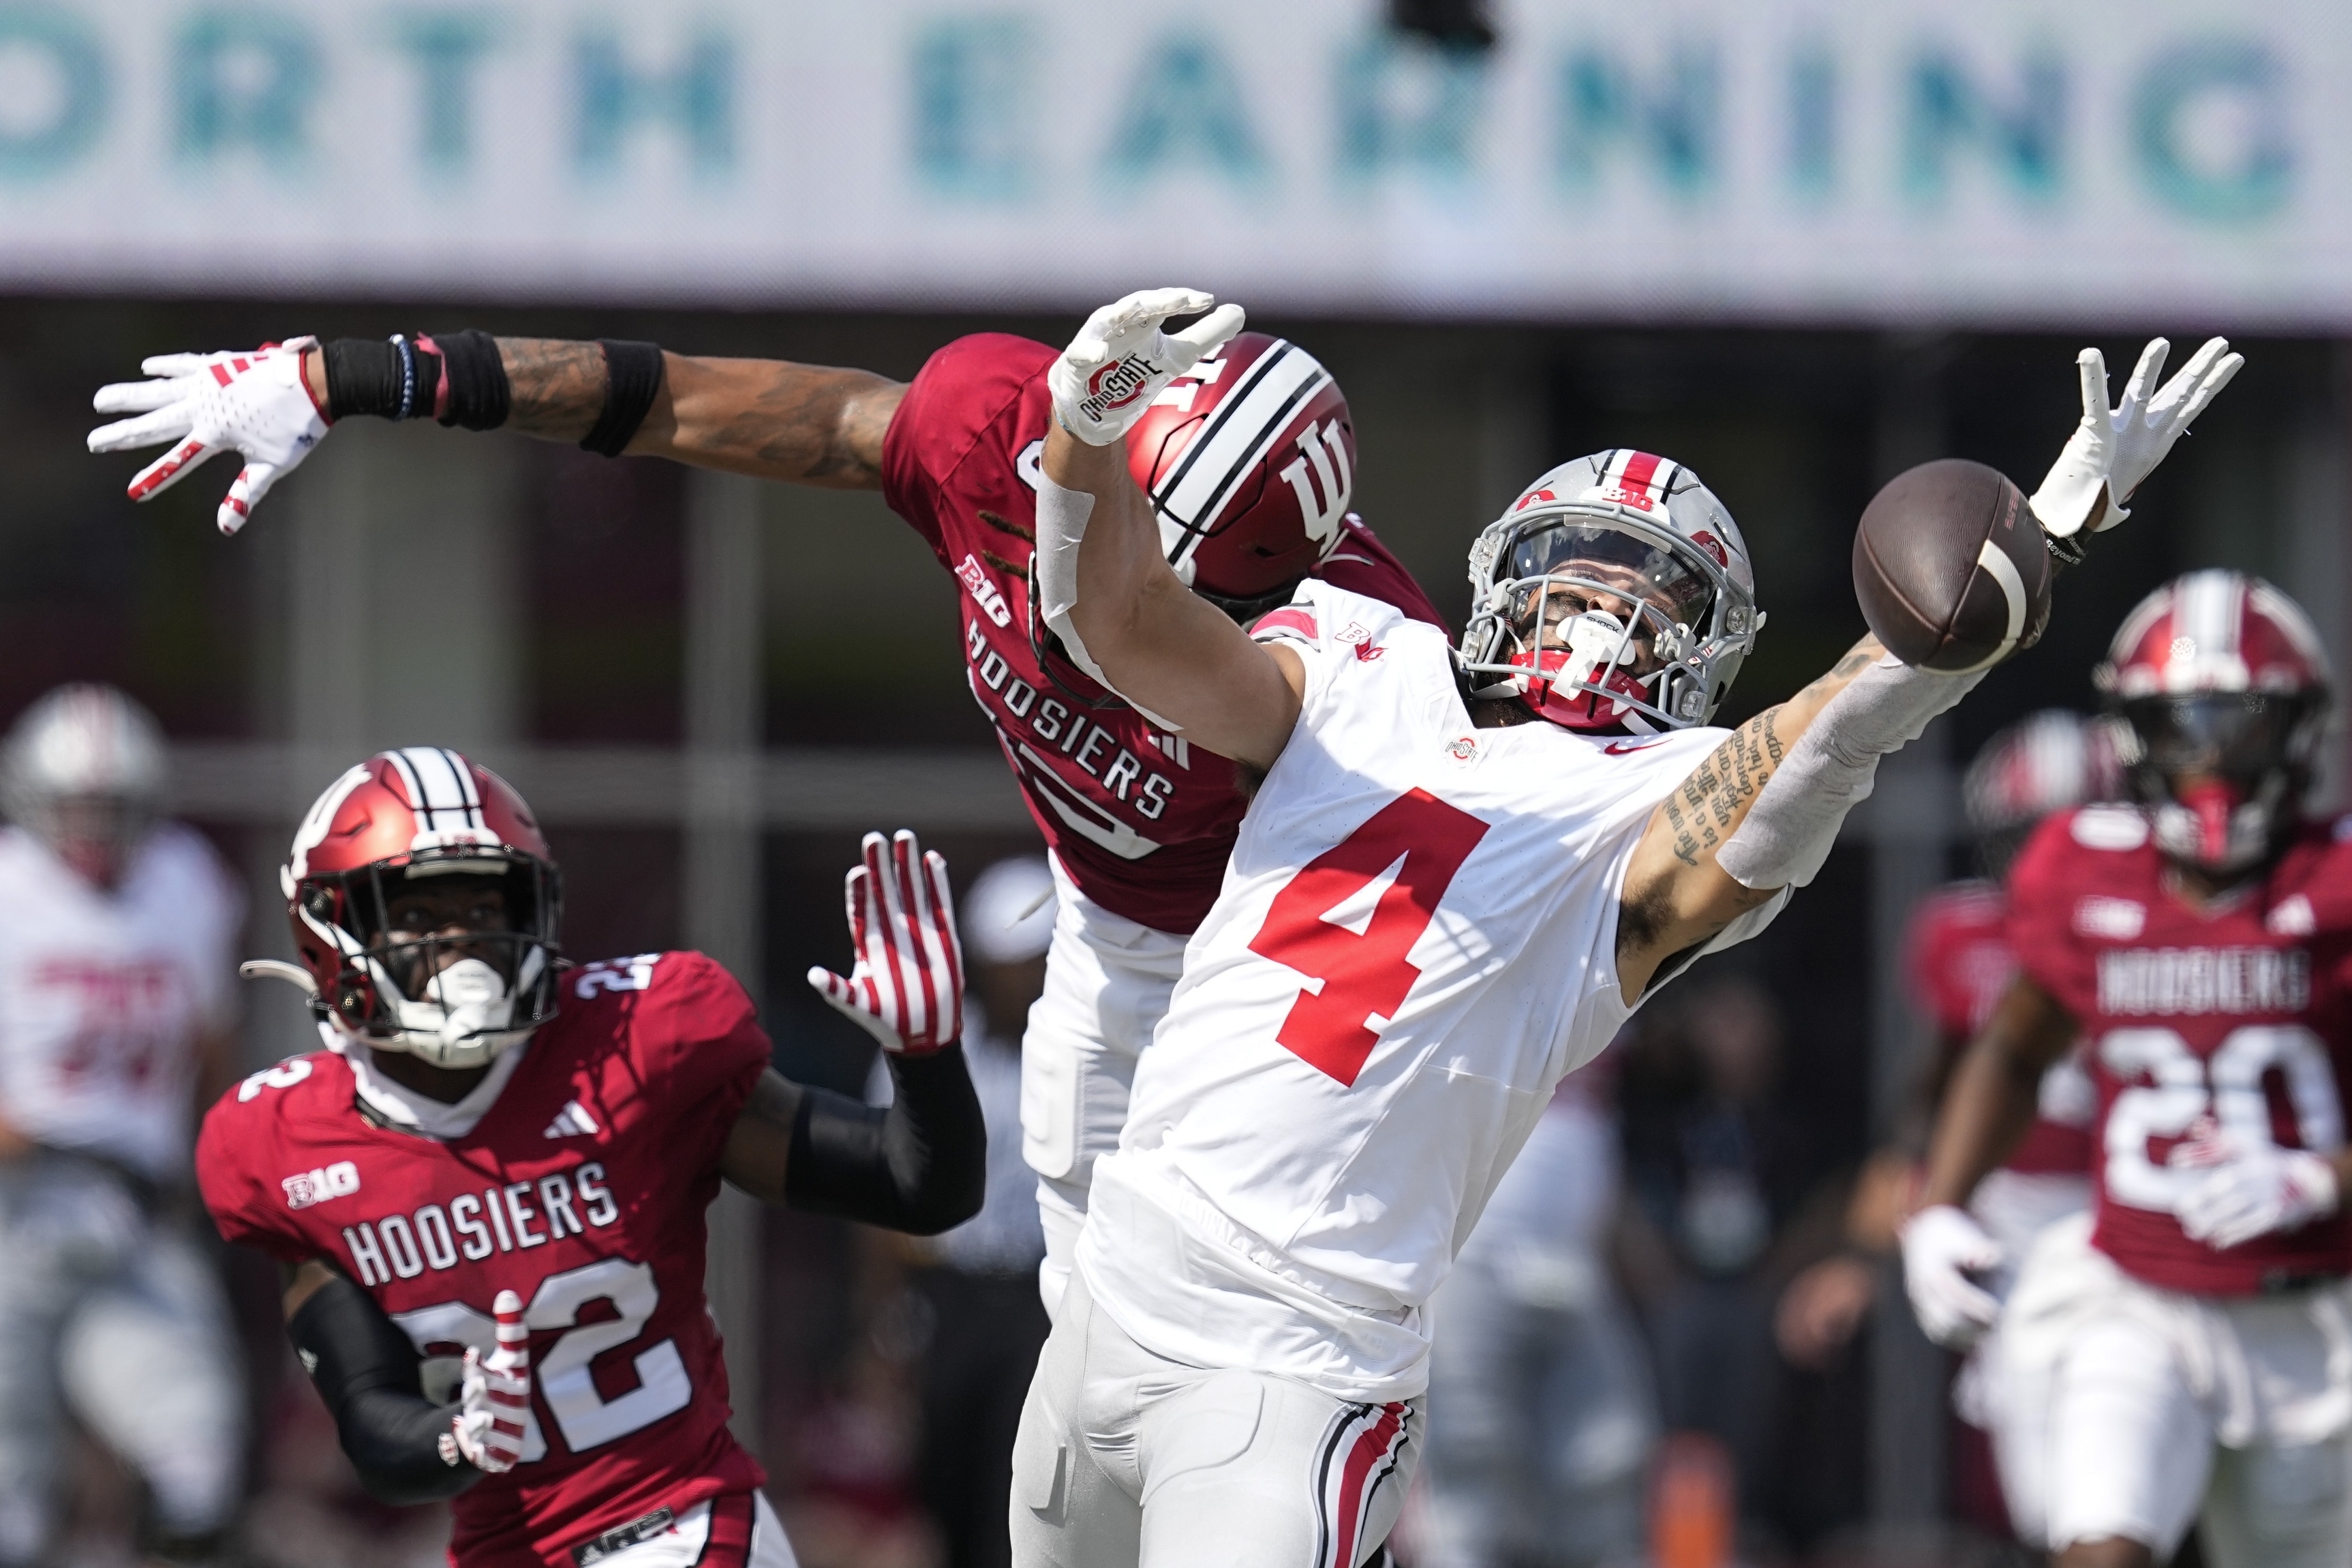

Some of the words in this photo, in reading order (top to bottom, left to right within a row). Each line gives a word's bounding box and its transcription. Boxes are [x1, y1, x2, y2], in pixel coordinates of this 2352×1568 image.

[906, 15, 2302, 219] EARNING
[1080, 390, 1116, 422] OHIO
[1105, 352, 1163, 397] STATE
[1586, 615, 1620, 634] SHOCK
[968, 616, 1175, 820] HOOSIERS
[1444, 741, 1463, 752] OHIO
[1459, 743, 1479, 764] STATE
[1694, 814, 1707, 827] a
[1711, 794, 1732, 829] you
[1674, 830, 1700, 866] The
[1703, 826, 1719, 849] is
[1247, 786, 1491, 1089] 4
[342, 1161, 620, 1287] HOOSIERS
